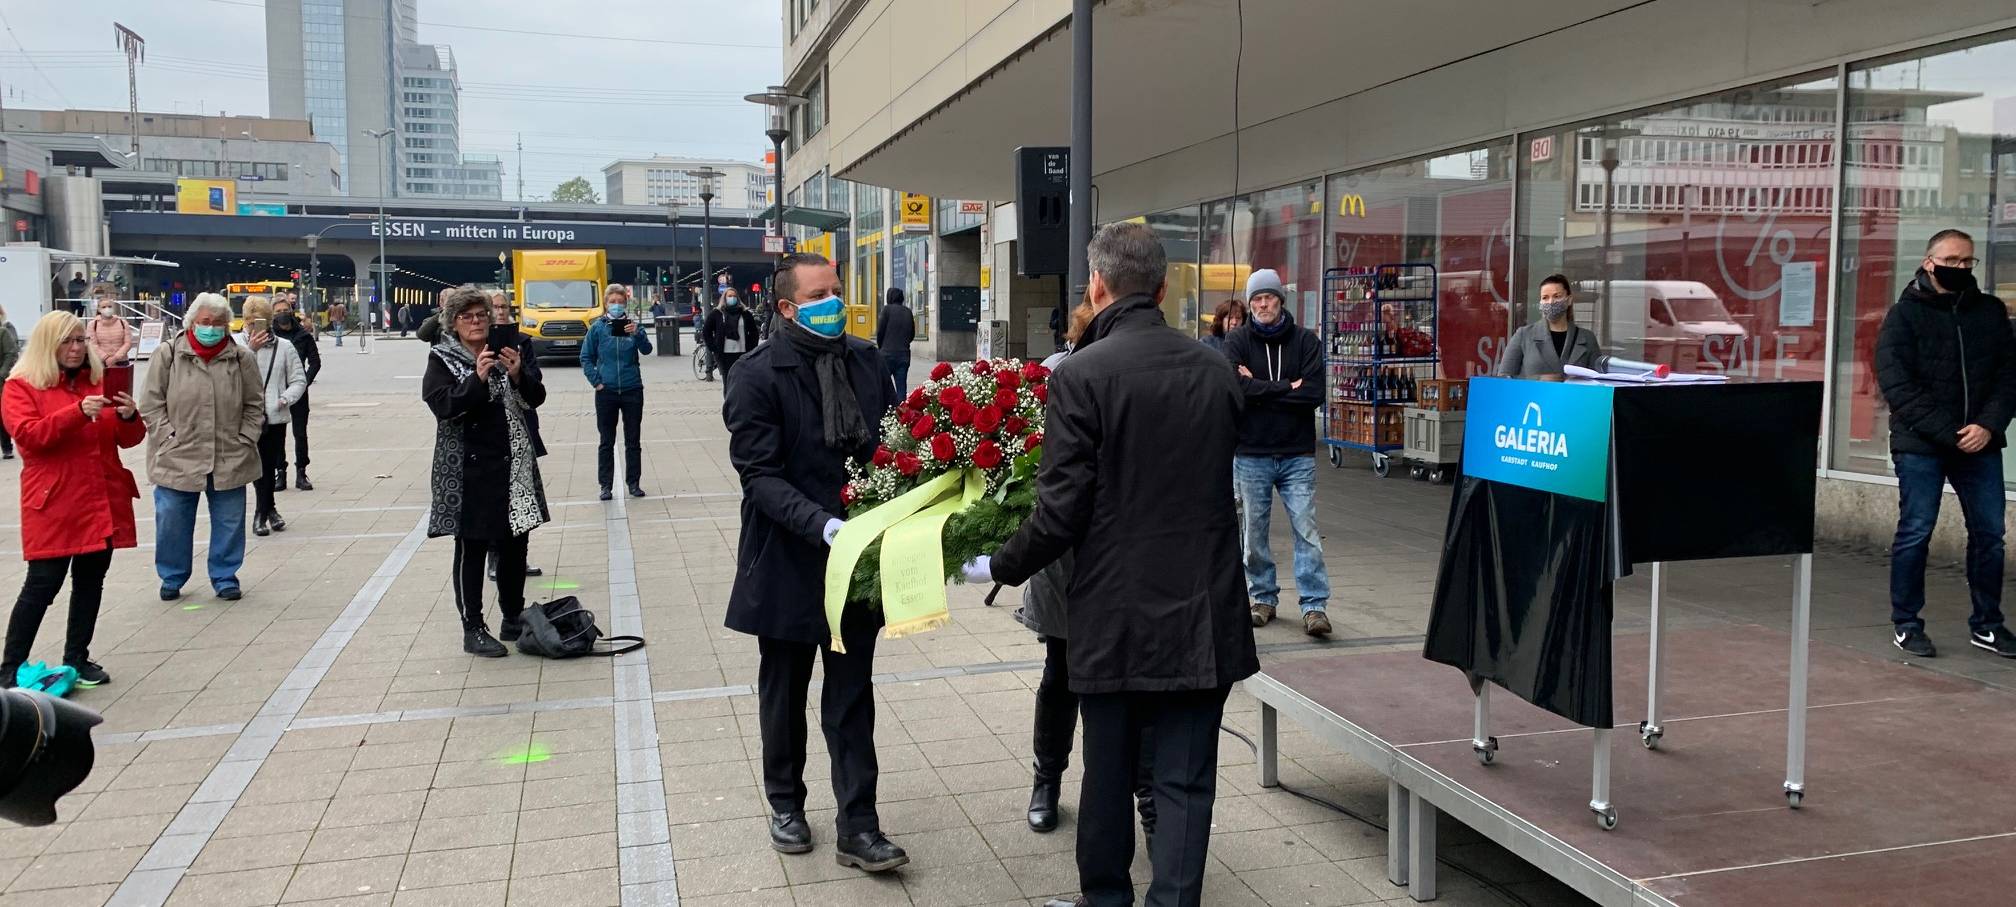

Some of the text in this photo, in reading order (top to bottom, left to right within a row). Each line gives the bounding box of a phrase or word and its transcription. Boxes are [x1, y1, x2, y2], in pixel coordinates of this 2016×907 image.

[371, 222, 425, 237] ESSEN
[446, 224, 497, 239] mitten
[503, 225, 517, 239] in
[522, 226, 575, 243] Europa
[1495, 425, 1568, 457] GALERIA
[1501, 455, 1558, 471] KARSTADT KAUFHOF
